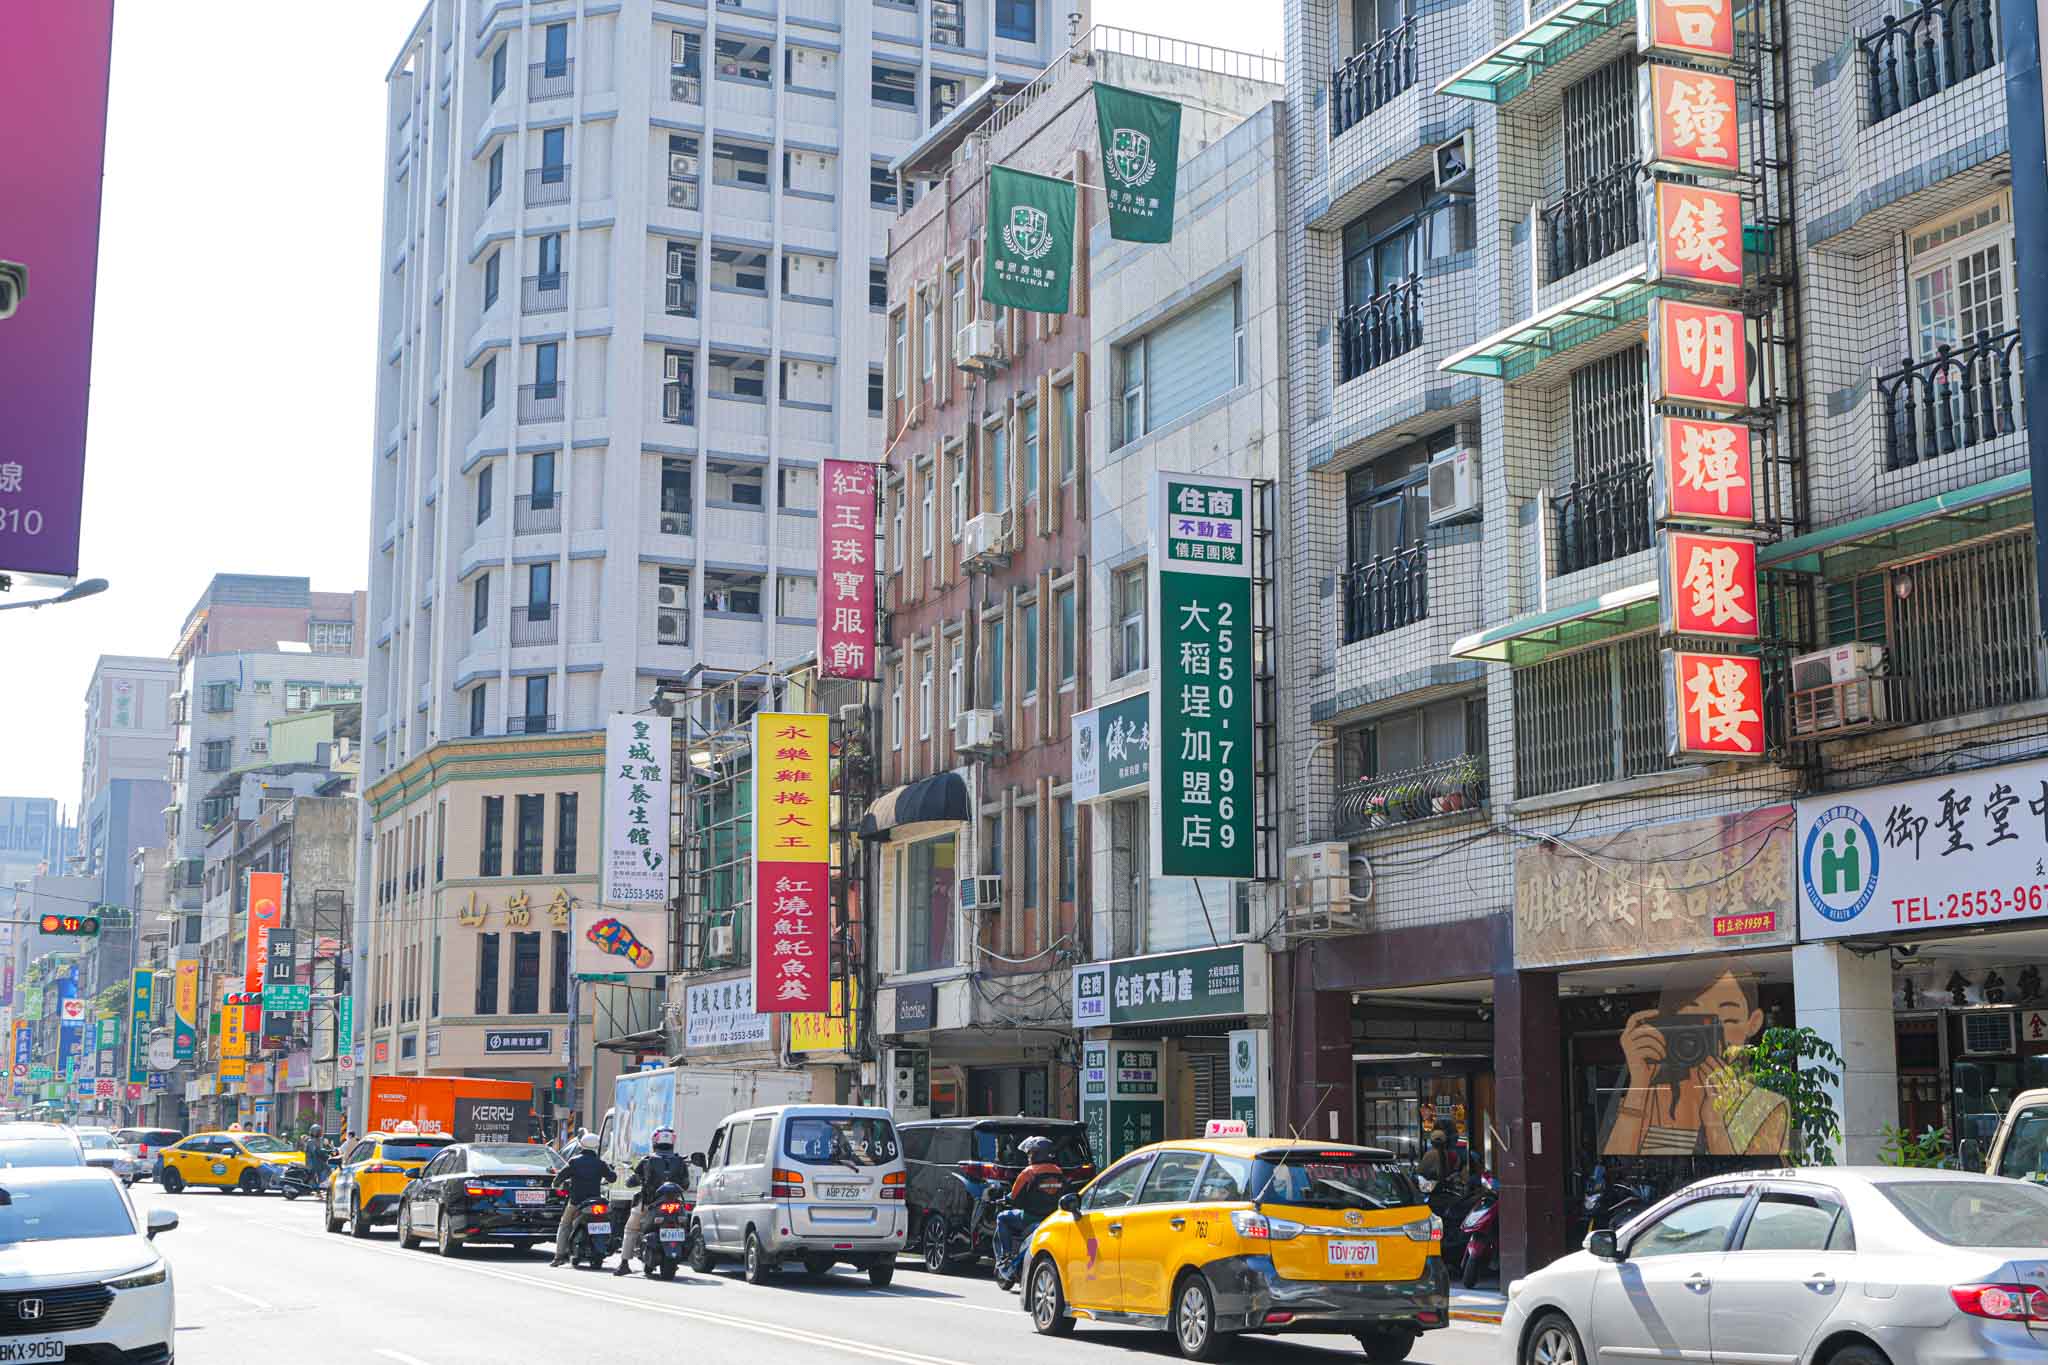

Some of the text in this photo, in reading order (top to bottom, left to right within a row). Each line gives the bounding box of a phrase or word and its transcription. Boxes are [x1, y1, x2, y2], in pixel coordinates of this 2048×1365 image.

[1117, 203, 1153, 217] TAIWAN
[1015, 275, 1049, 288] TAIWAN
[1177, 487, 1234, 516] 住商
[1178, 519, 1233, 539] 不動產
[1175, 541, 1236, 562] 儀居團隊
[831, 468, 865, 670] 紅玉珠寶服飾
[1179, 600, 1212, 850] 大稻埕加盟店
[619, 720, 662, 846] 皇城足體養生館
[612, 887, 664, 900] 02-2553-5456
[1829, 908, 1851, 920] HEALTH
[1081, 975, 1102, 996] 住商
[1115, 967, 1193, 1009] 住商不動產
[1081, 1000, 1104, 1017] 不動產
[1122, 1052, 1153, 1067] 住商
[471, 1105, 514, 1122] KERRY
